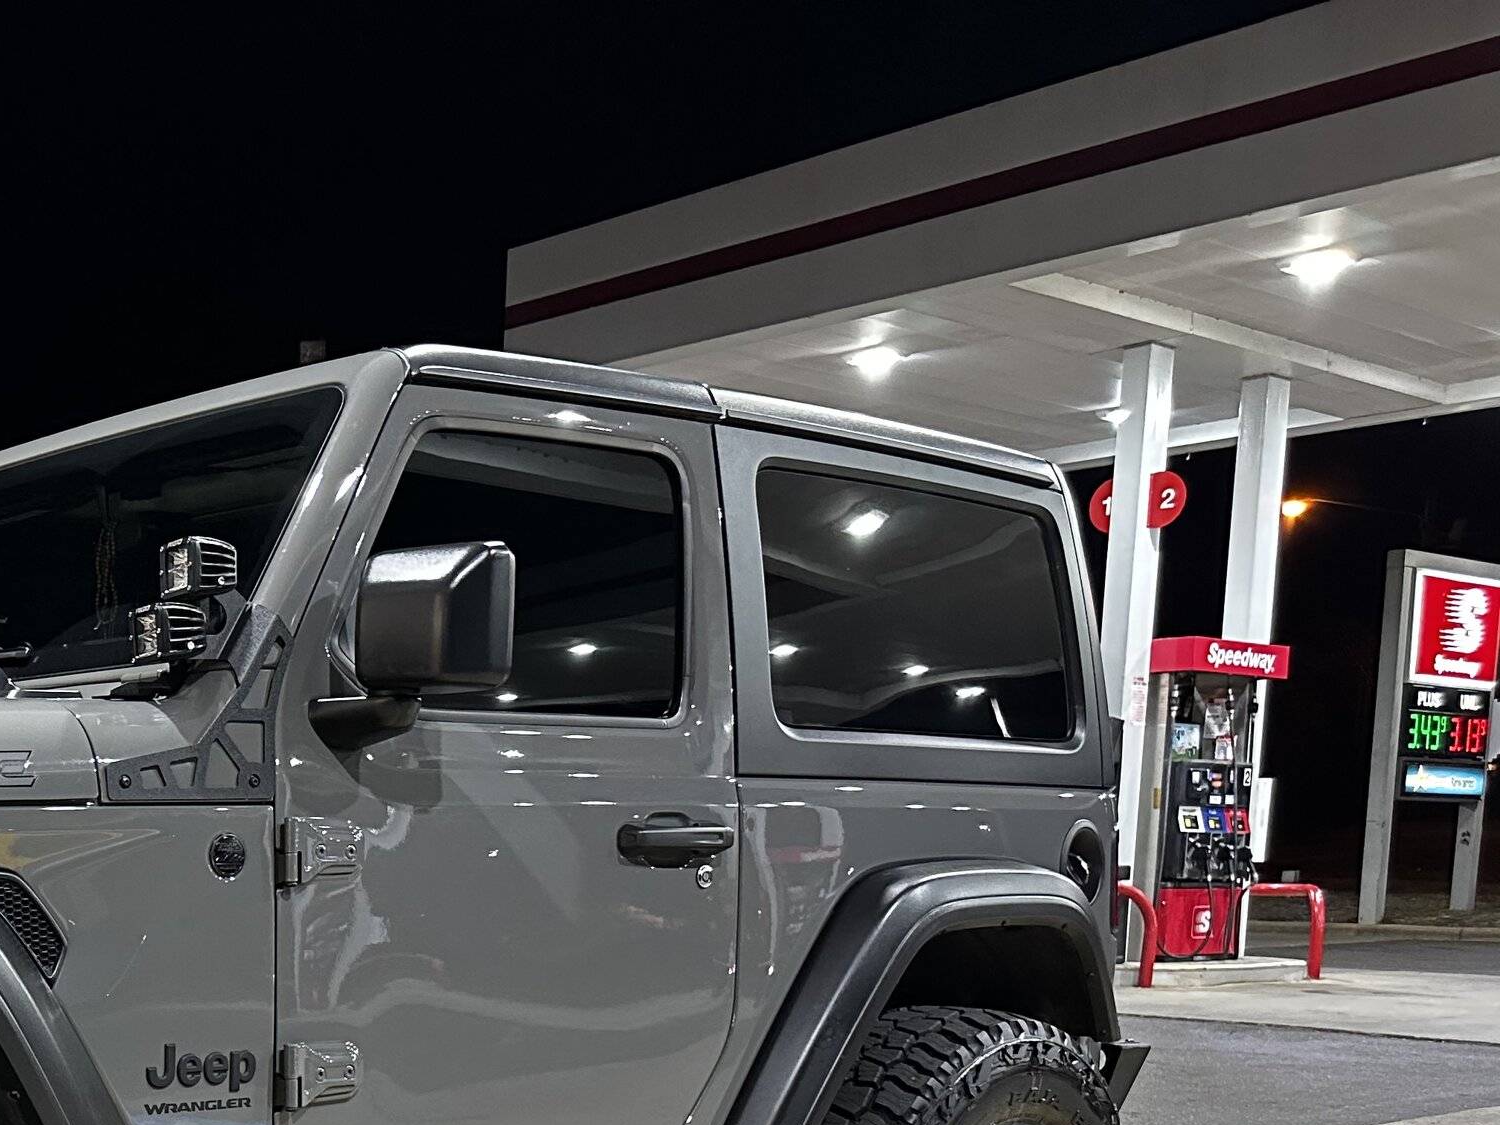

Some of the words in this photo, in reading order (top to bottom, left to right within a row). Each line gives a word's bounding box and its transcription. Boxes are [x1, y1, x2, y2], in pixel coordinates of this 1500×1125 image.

[1102, 496, 1112, 516] 1
[1160, 488, 1176, 509] 2
[1207, 642, 1276, 674] Speedway
[1245, 770, 1252, 785] 2
[145, 1043, 257, 1093] Jeep
[144, 1097, 252, 1116] WRANGLER
